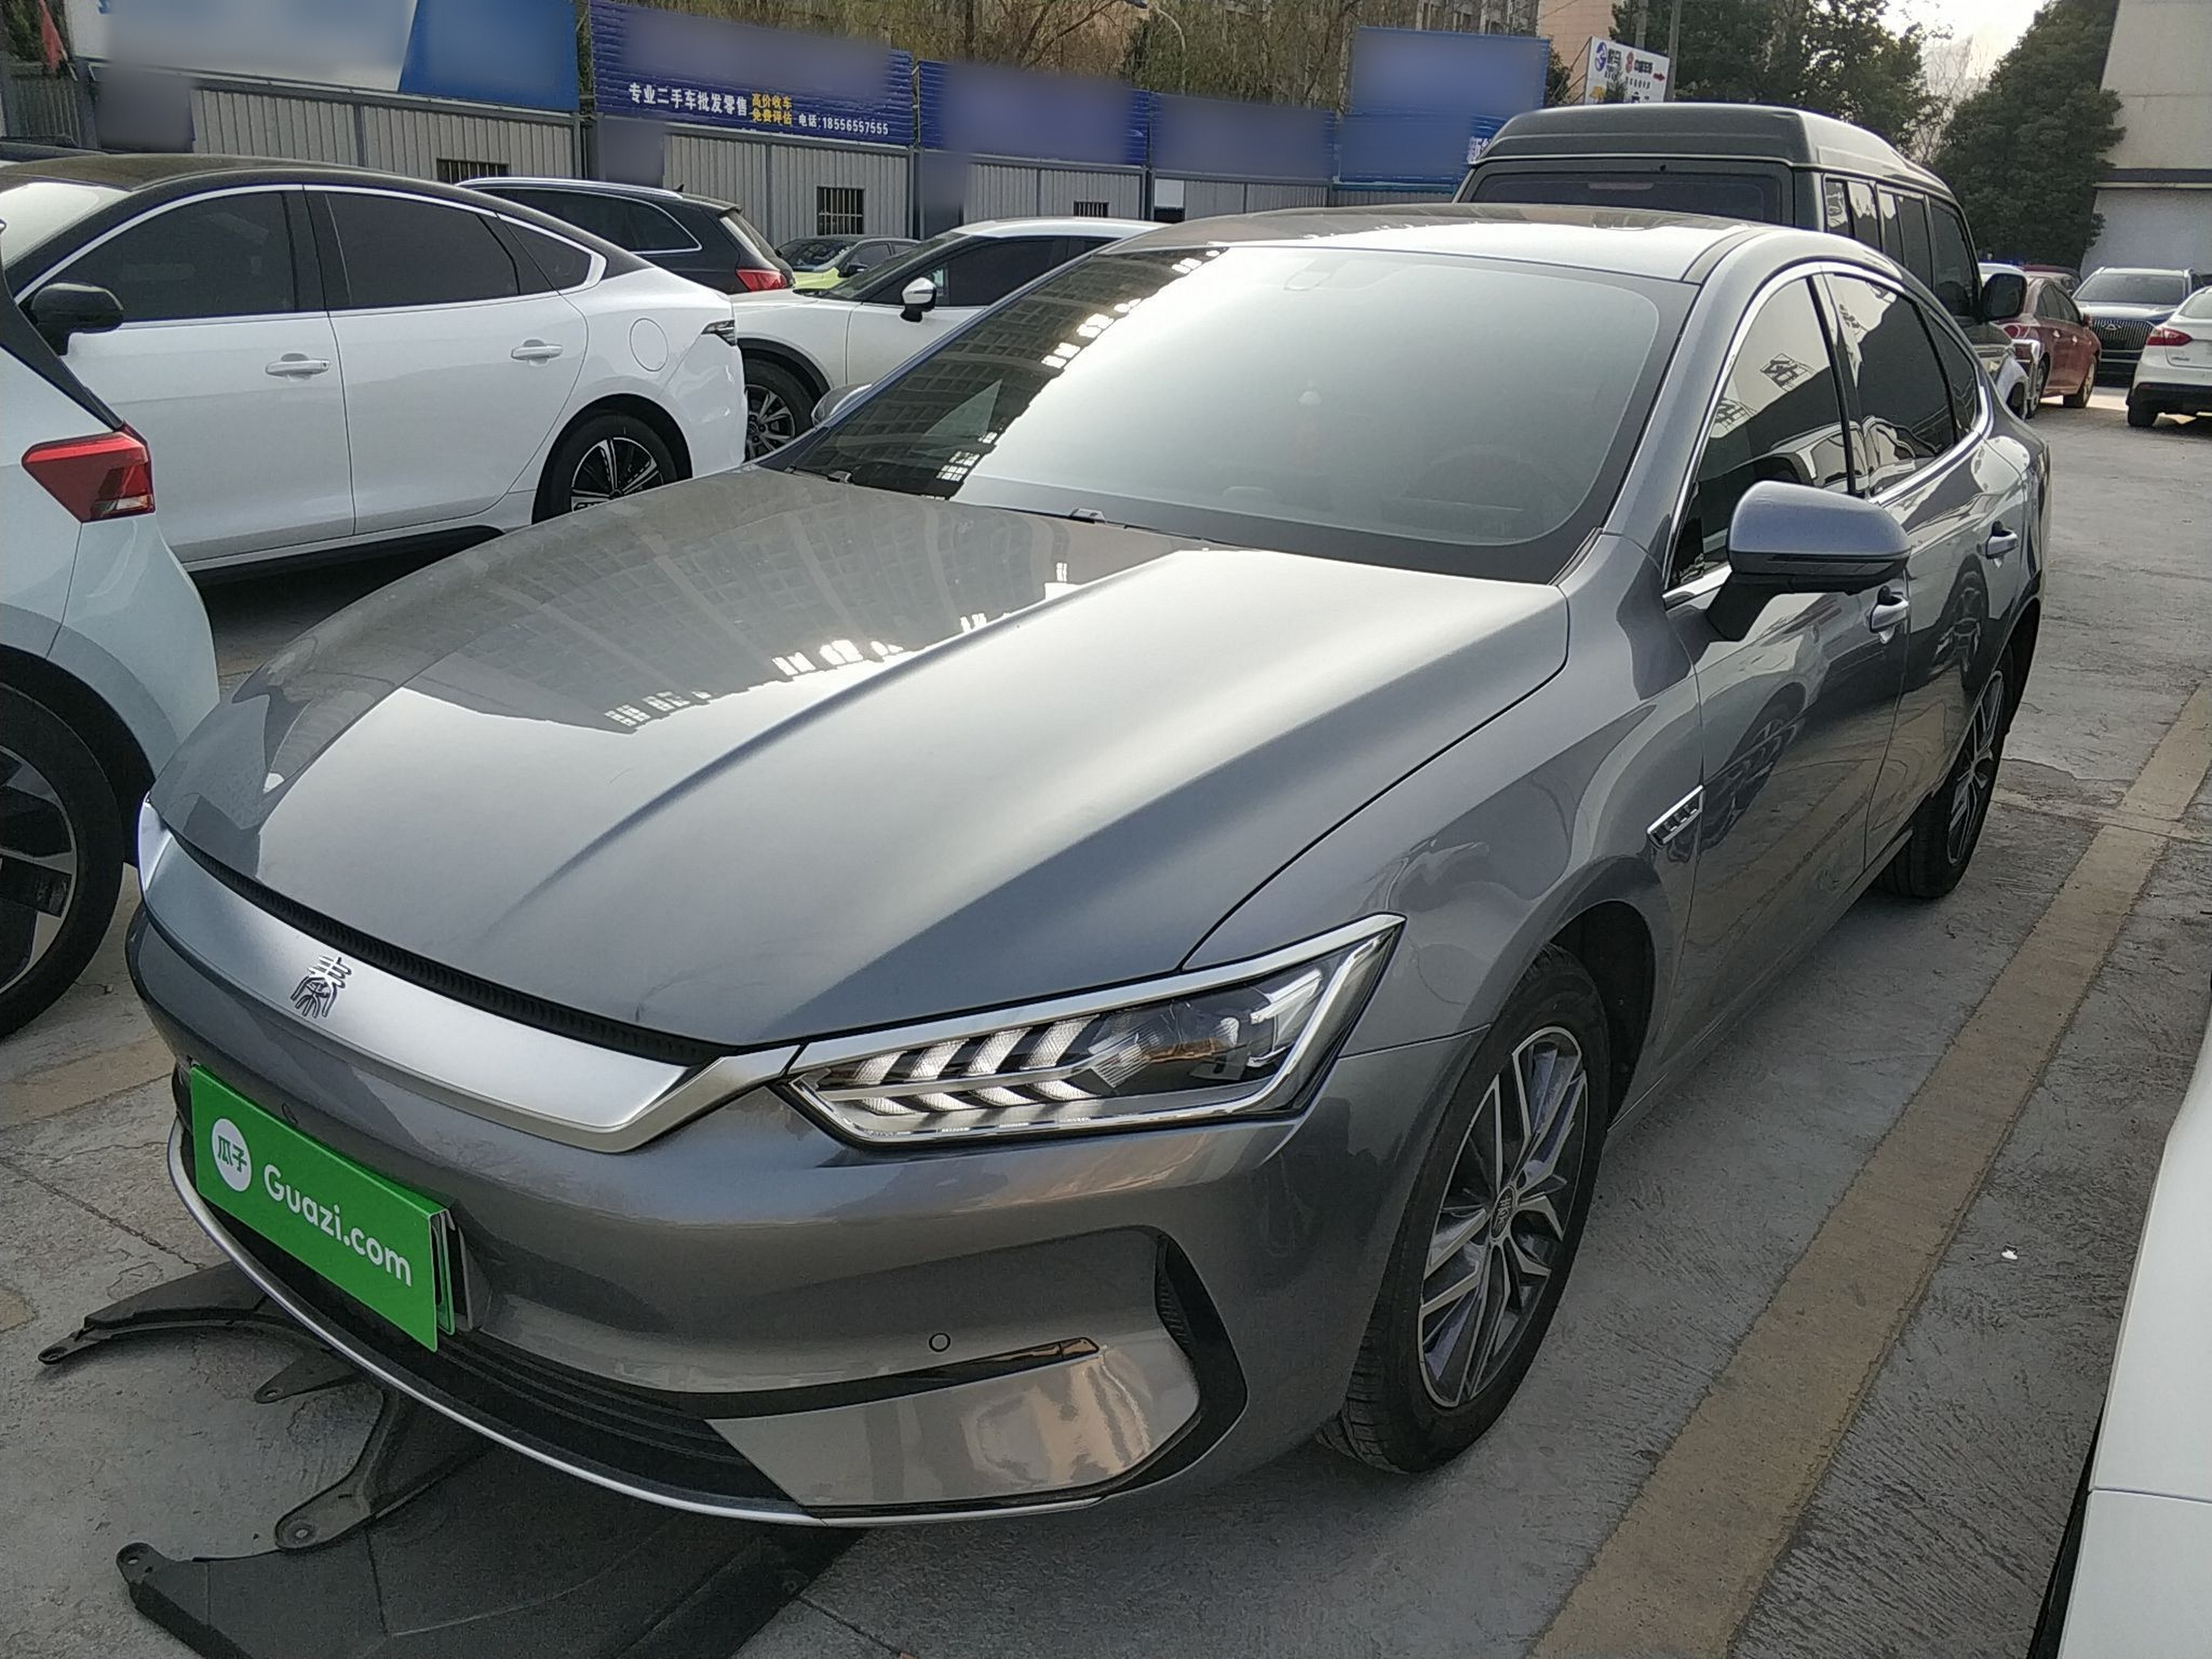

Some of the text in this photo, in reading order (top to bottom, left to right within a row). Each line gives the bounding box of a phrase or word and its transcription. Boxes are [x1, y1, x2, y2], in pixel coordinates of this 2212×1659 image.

[628, 82, 748, 116] 专业二手车批发零售
[751, 92, 793, 110] 高价收车
[751, 108, 793, 125] 免费评估
[218, 1134, 248, 1173] 瓜子
[263, 1164, 412, 1287] Guazi.com
